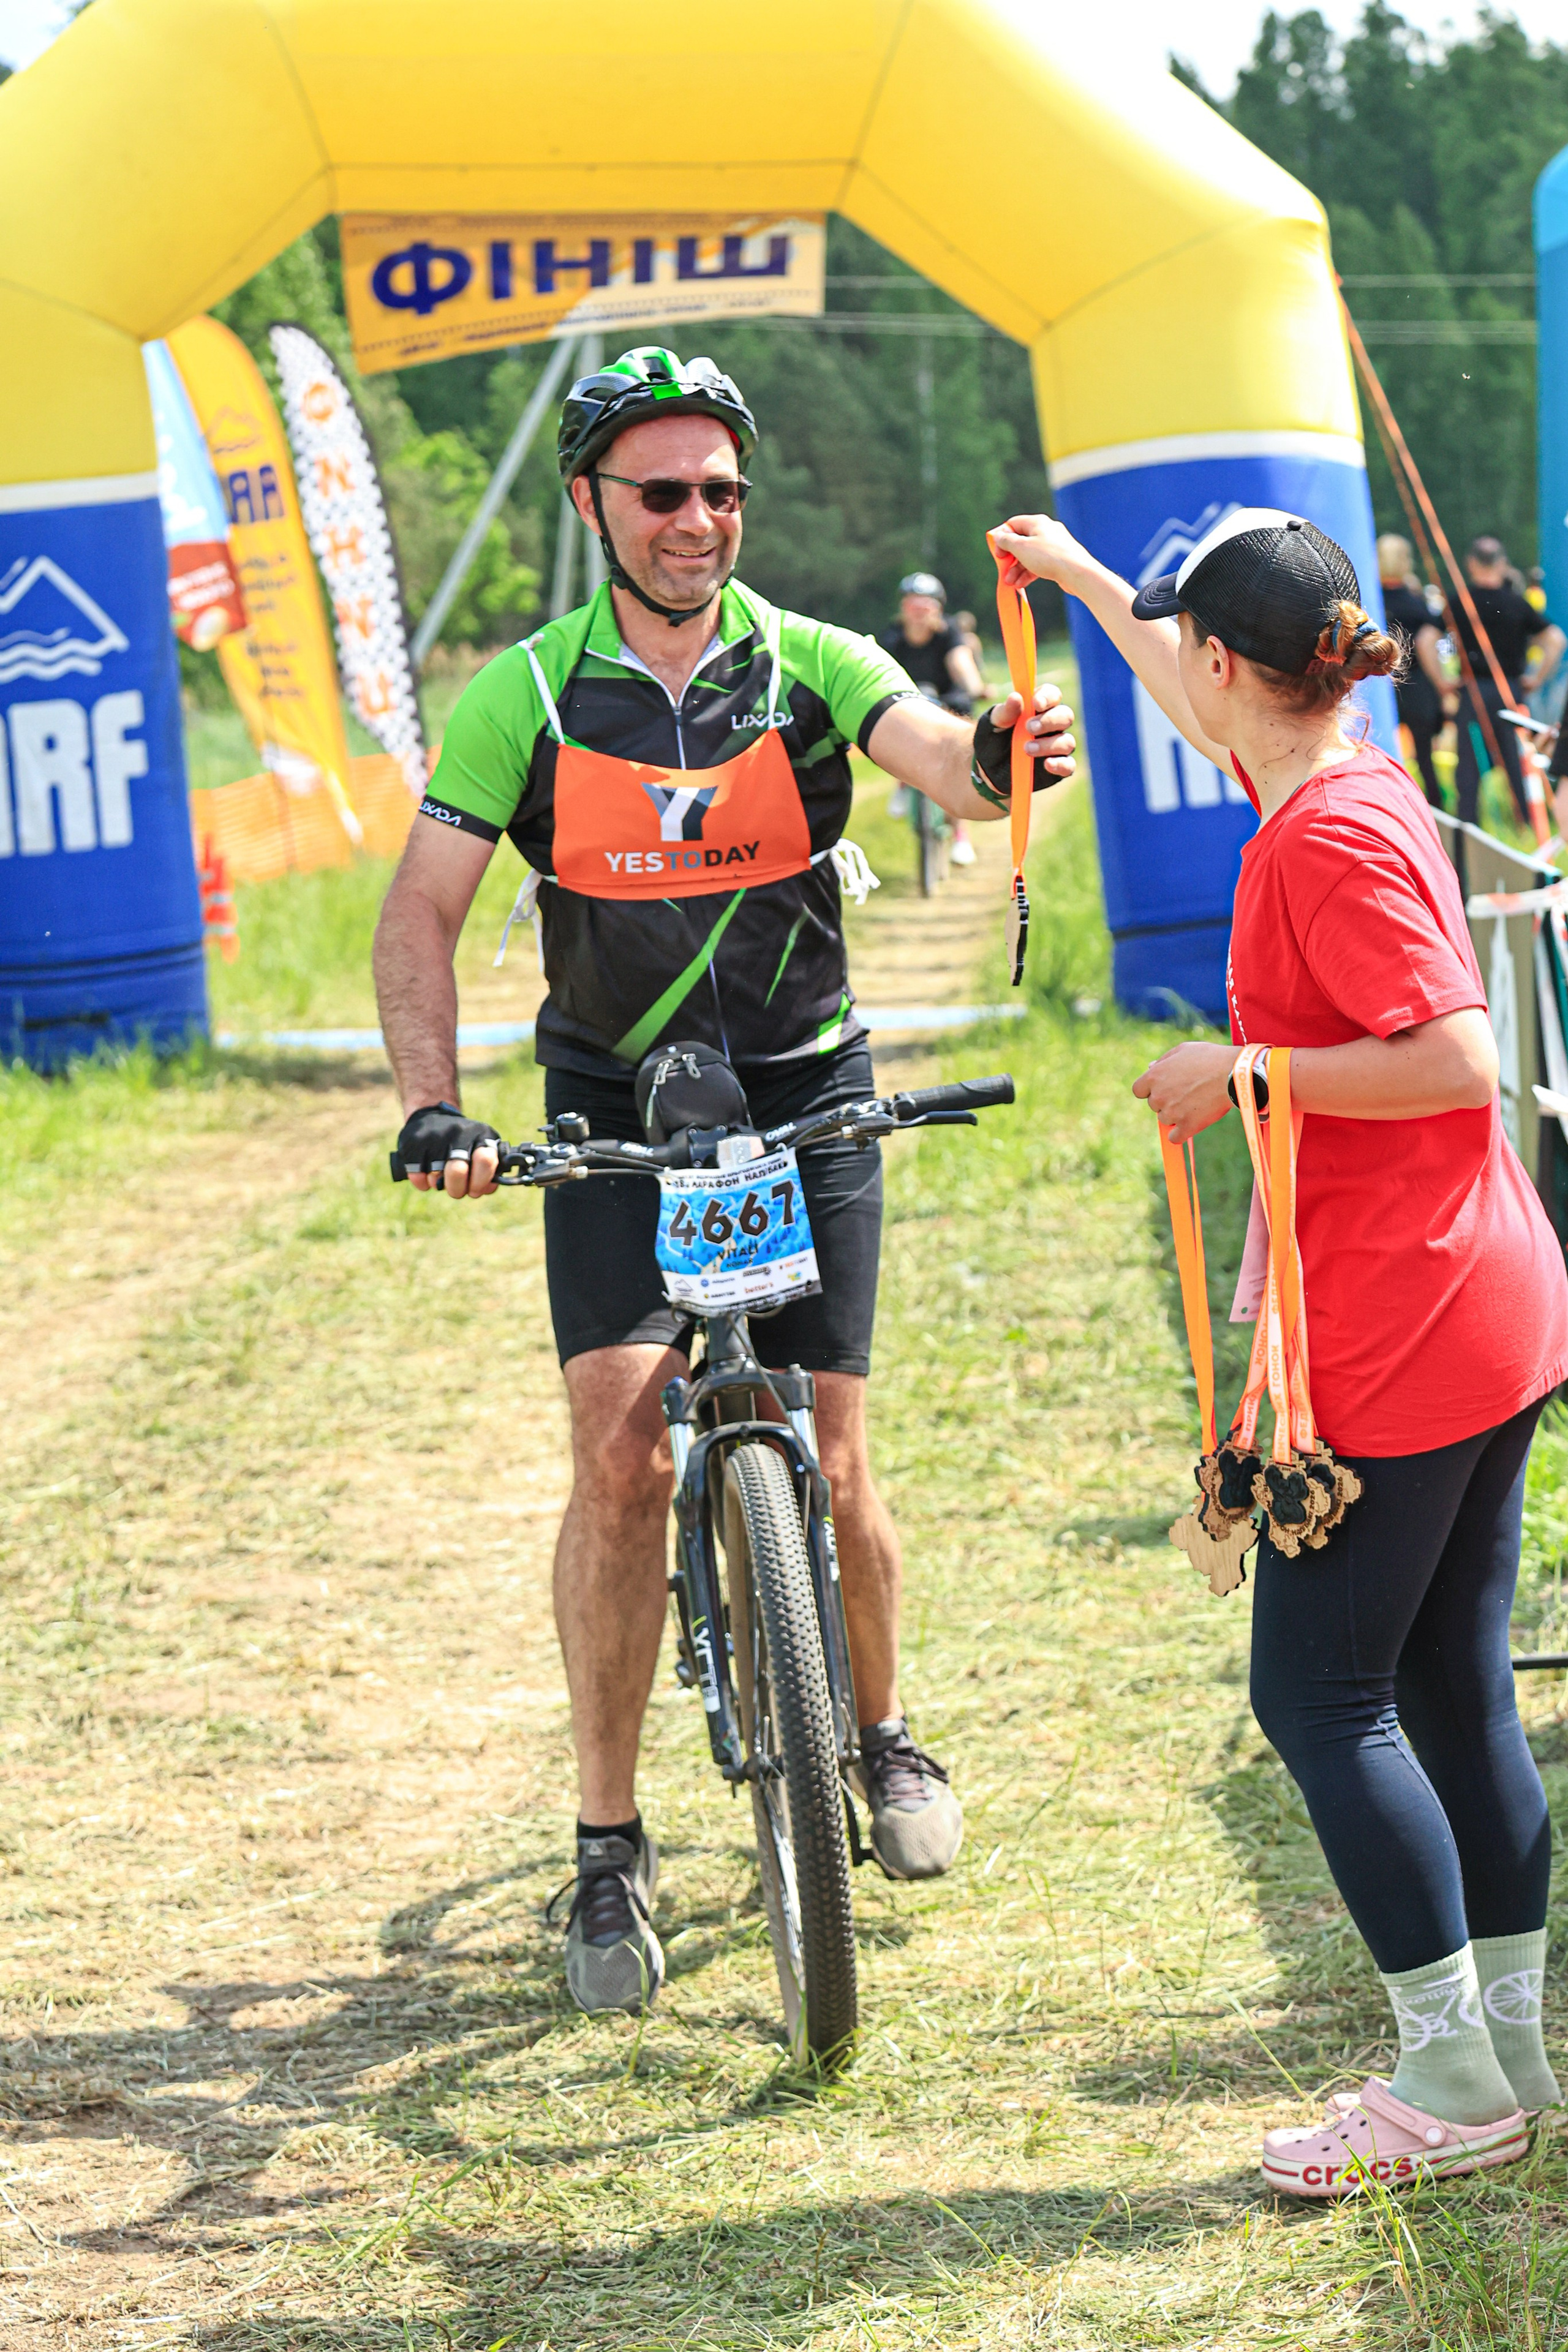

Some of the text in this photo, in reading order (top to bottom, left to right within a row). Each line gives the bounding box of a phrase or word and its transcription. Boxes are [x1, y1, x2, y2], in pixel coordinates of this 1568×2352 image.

[372, 233, 790, 316] ФІНІШ
[0, 689, 149, 857] RF
[604, 840, 761, 873] YESTODAY
[669, 1177, 796, 1246] 4667
